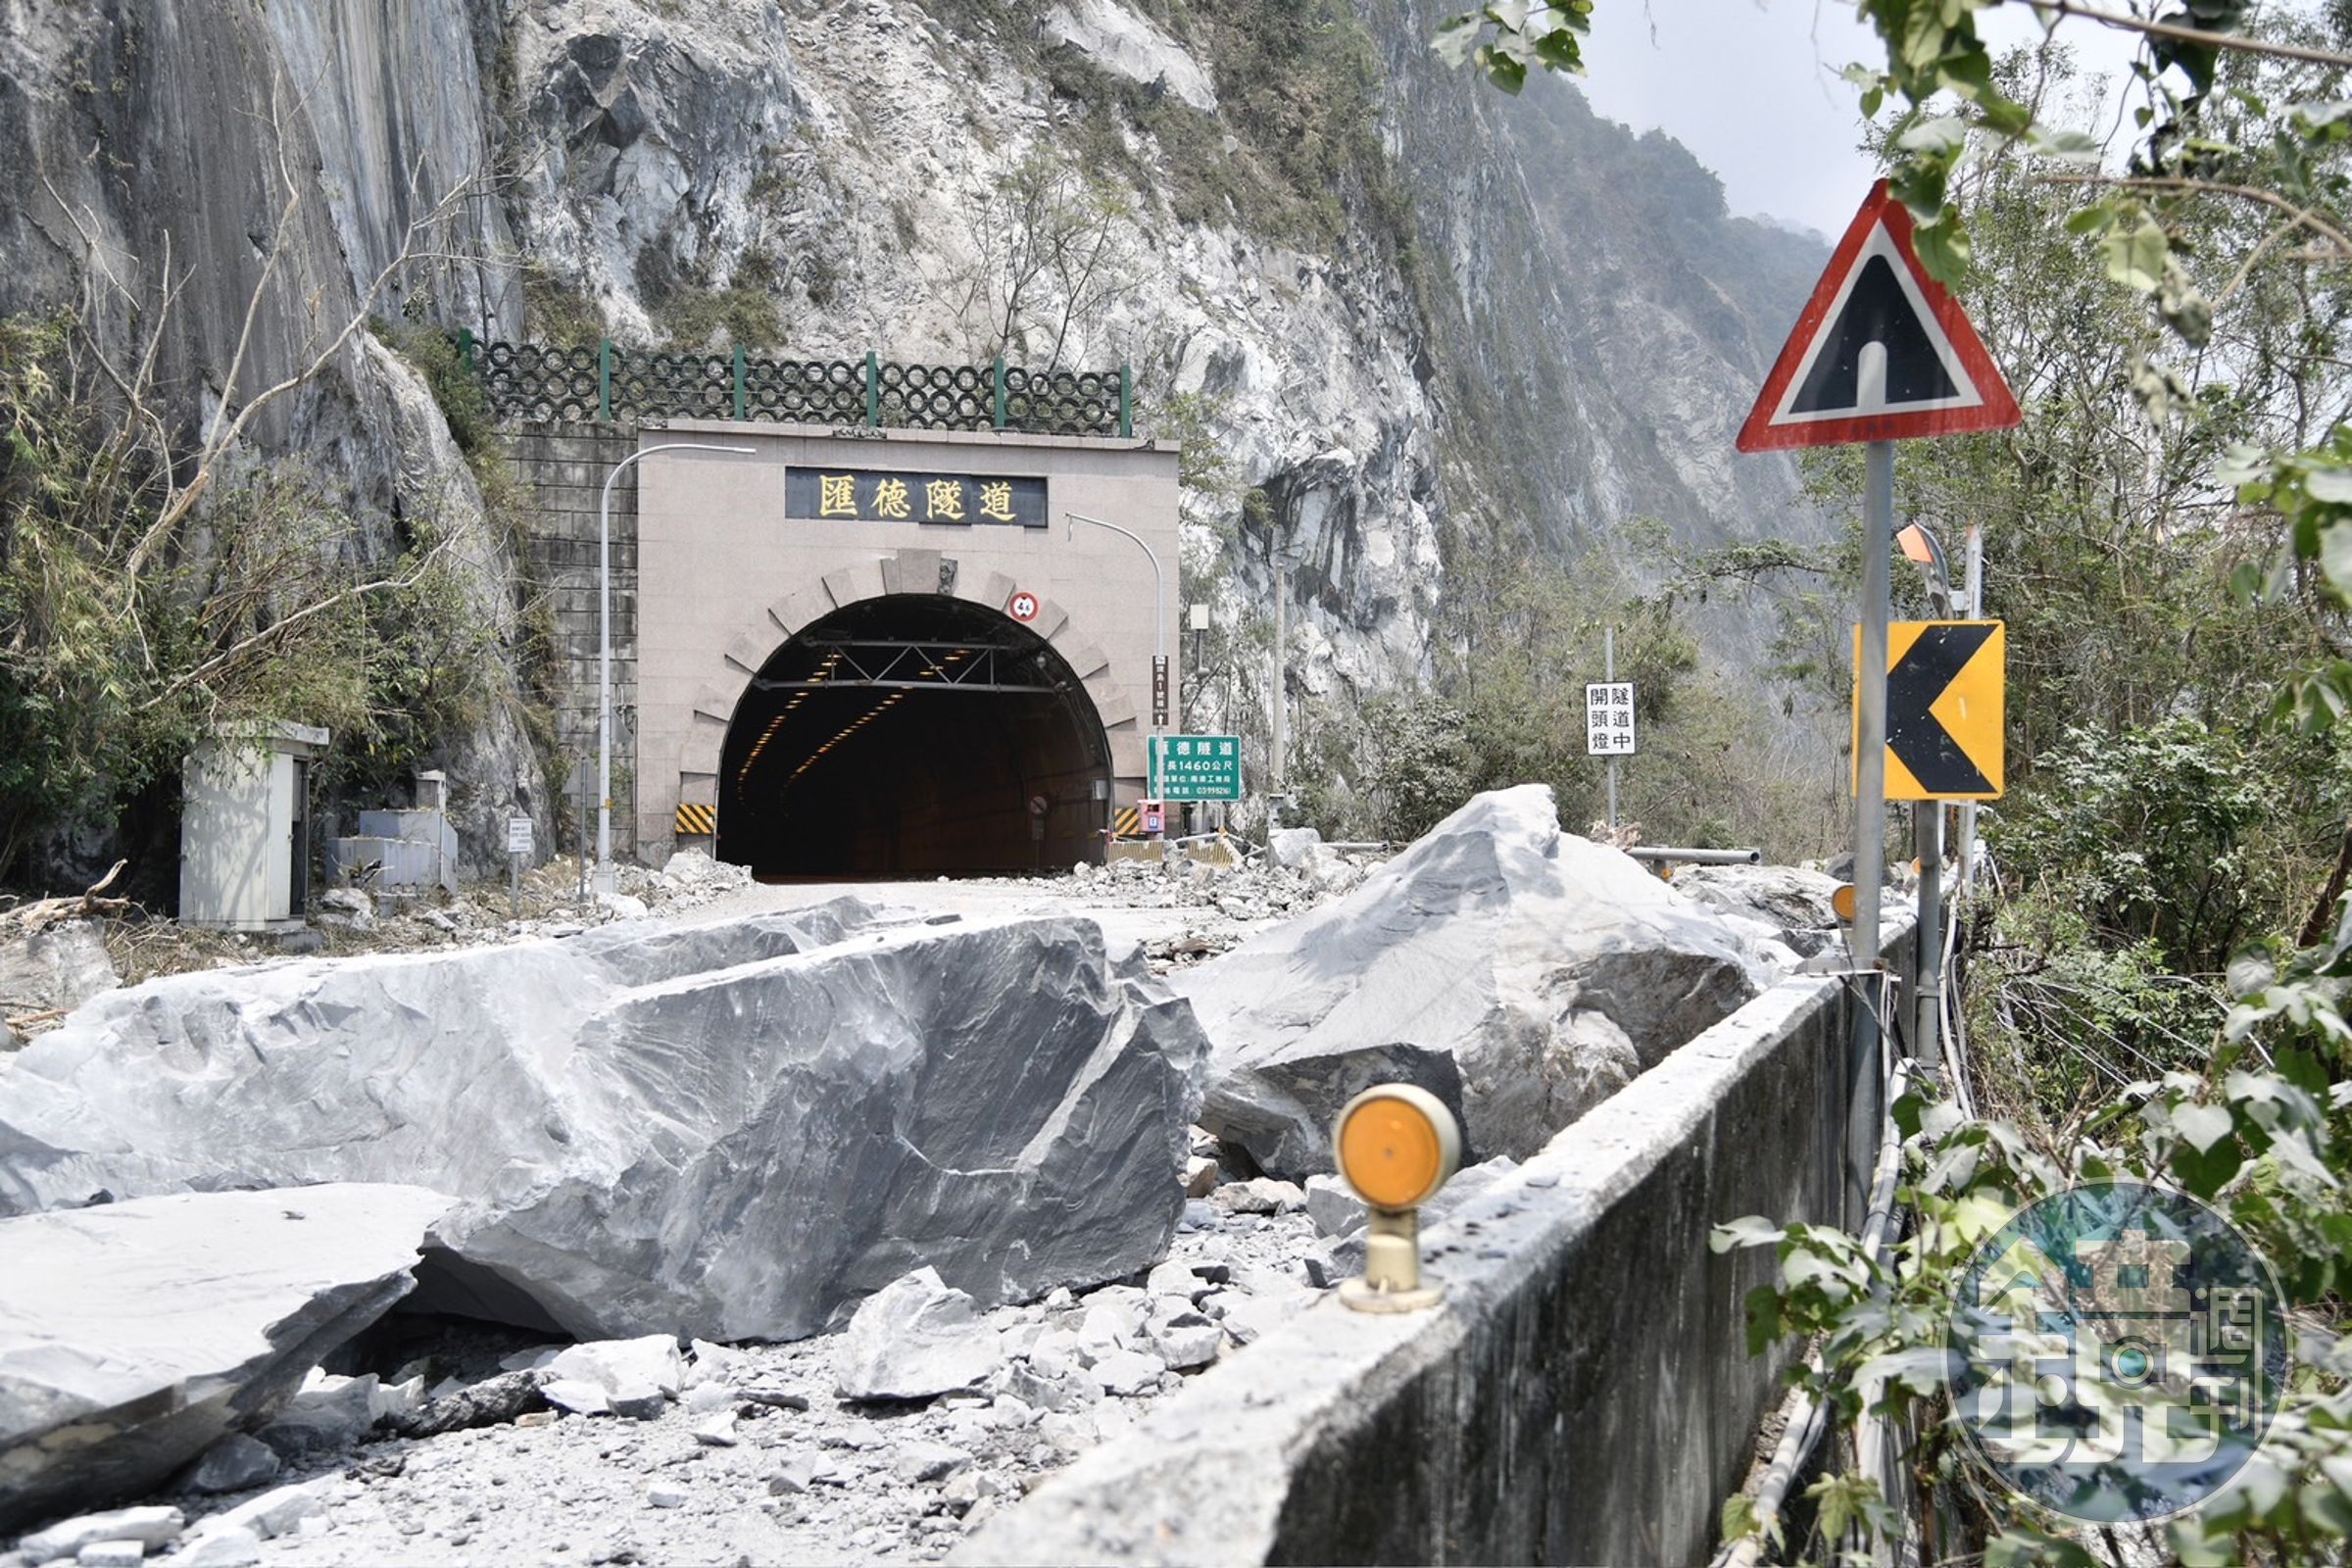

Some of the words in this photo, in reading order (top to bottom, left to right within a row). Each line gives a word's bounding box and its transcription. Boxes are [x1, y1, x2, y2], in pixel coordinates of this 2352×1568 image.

[819, 474, 1017, 521] 匯德隧道
[1591, 688, 1609, 750] 開頭燈
[1612, 687, 1631, 750] 隧道中
[1156, 760, 1233, 771] 長1460公尺
